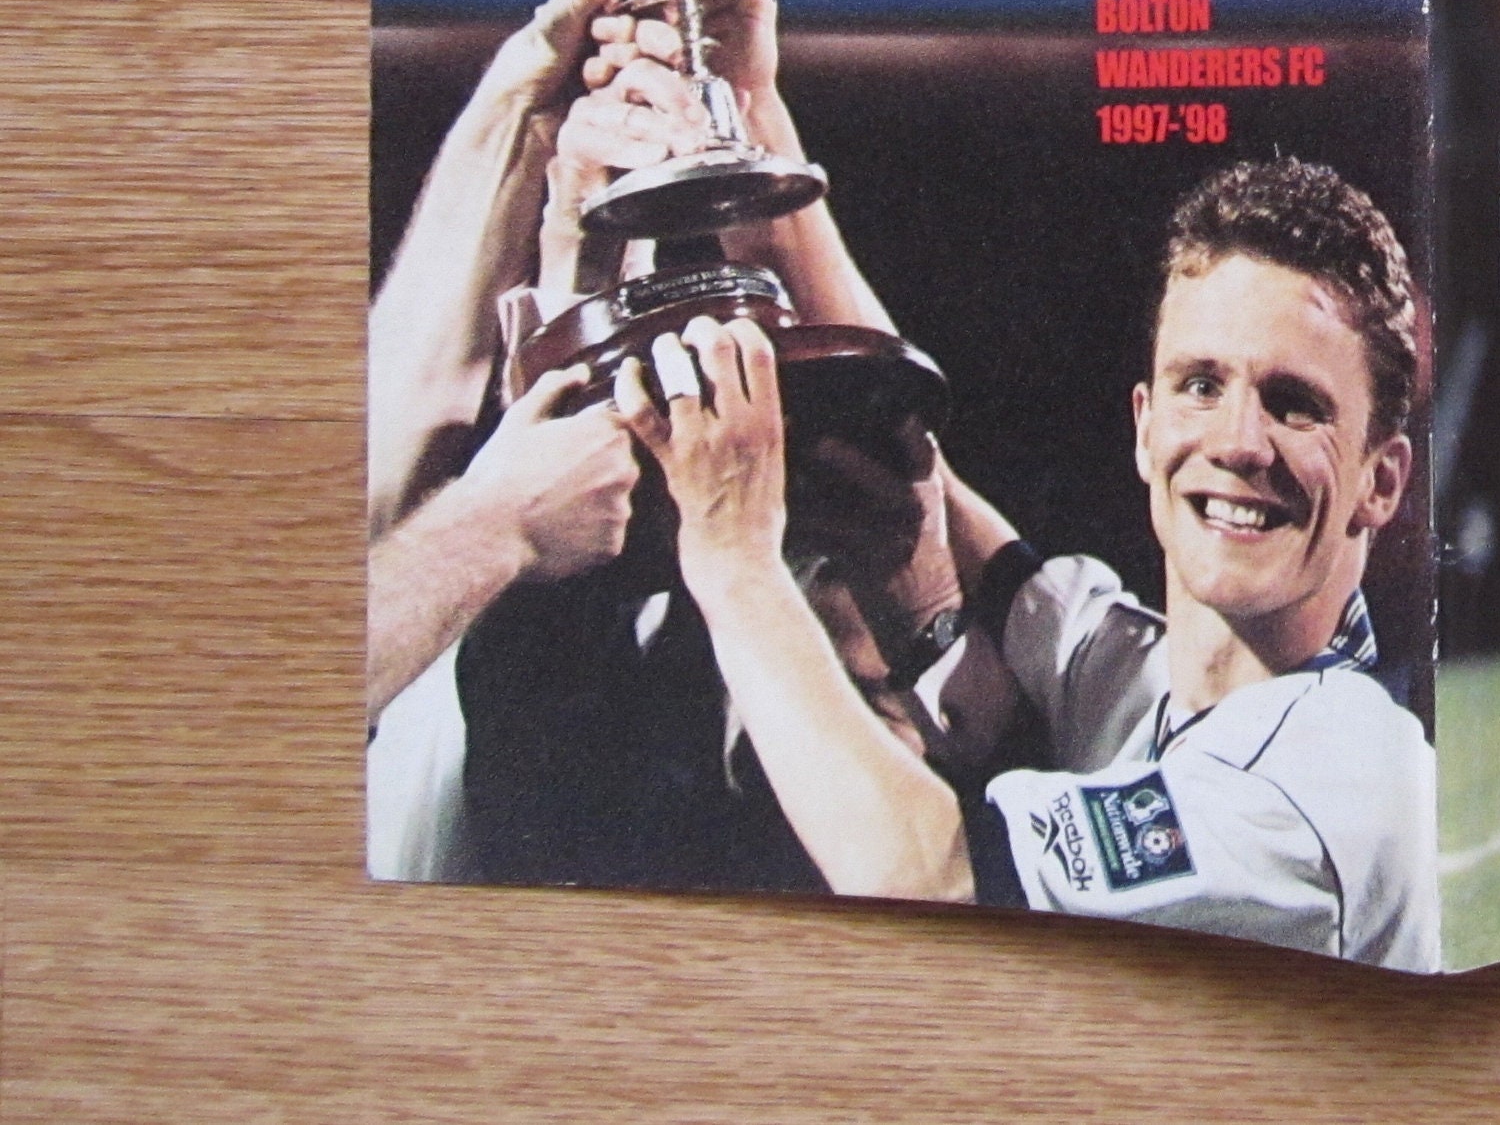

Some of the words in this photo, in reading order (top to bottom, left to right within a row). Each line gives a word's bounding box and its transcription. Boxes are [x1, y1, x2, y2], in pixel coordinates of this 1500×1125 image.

[1096, 46, 1283, 88] WANDERERS
[1288, 45, 1326, 86] FC
[1096, 103, 1228, 143] 1997-'98
